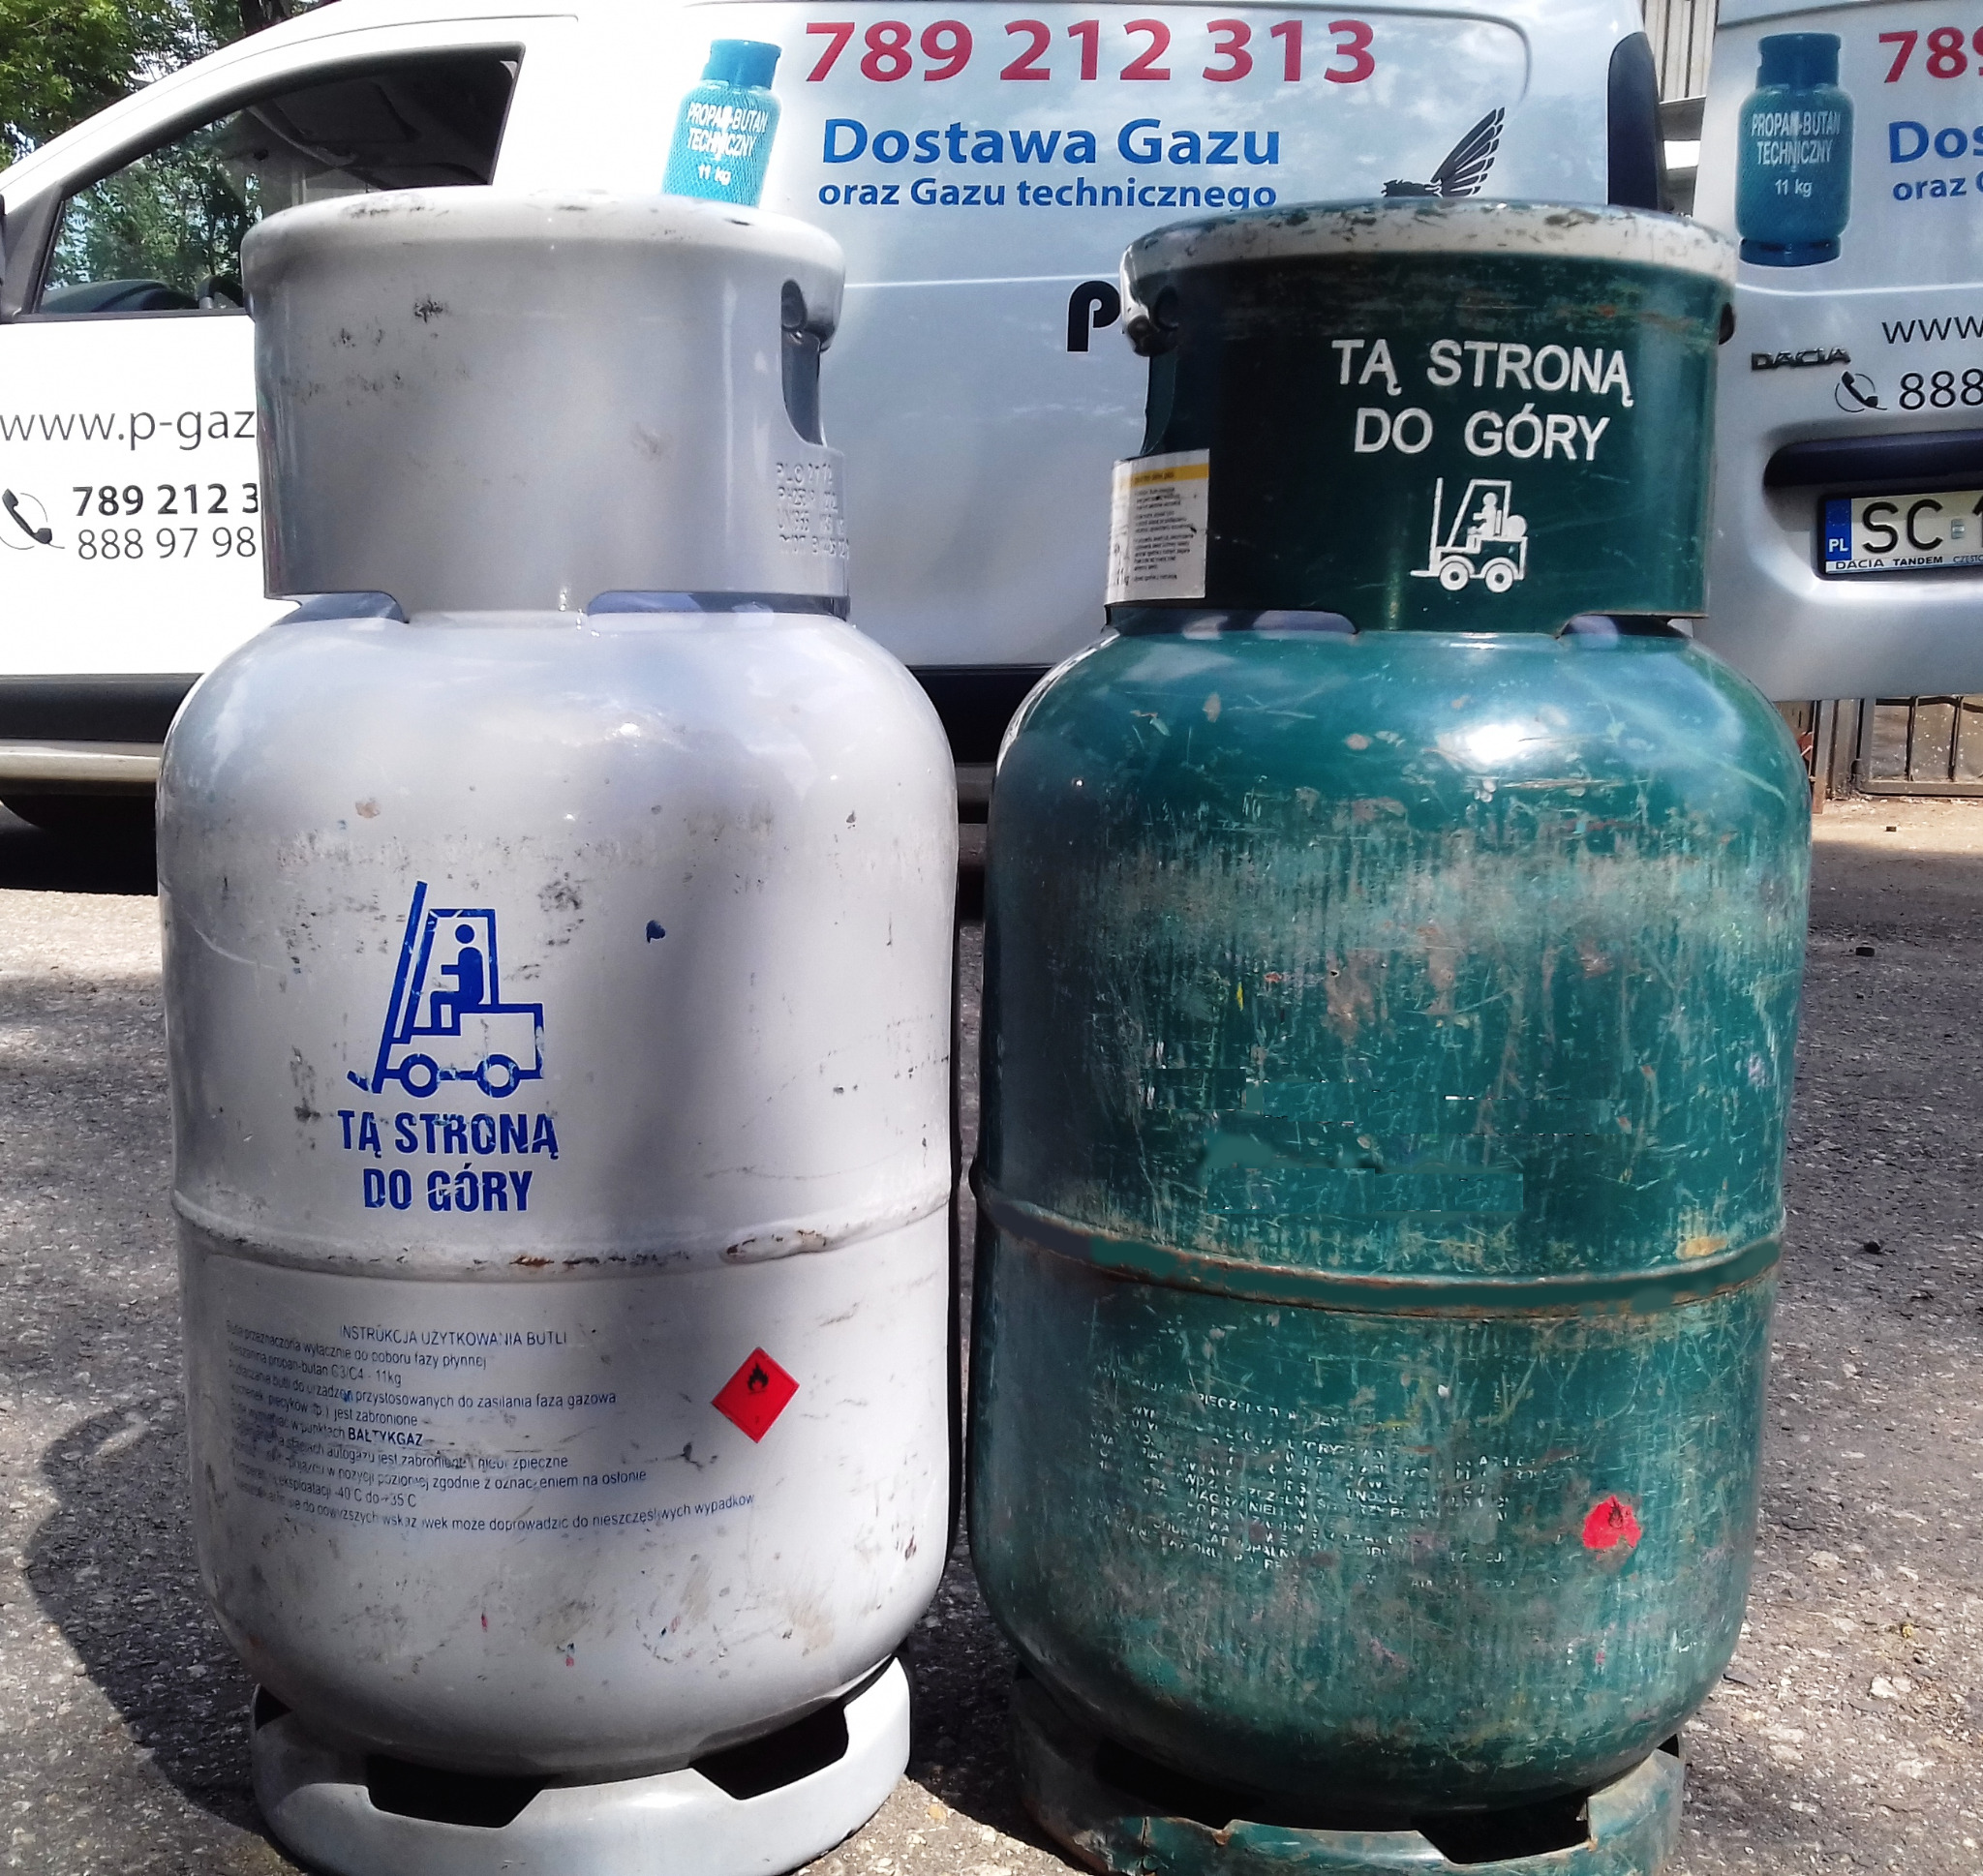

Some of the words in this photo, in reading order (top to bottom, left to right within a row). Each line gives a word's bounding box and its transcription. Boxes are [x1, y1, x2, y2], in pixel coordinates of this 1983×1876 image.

[805, 20, 973, 82] 789
[999, 19, 1171, 82] 212
[1202, 19, 1375, 84] 313
[1878, 25, 1983, 83] 78
[822, 118, 1097, 165] Dostawa
[1117, 117, 1280, 165] Gazu
[1756, 139, 1834, 166] TECHNICZNY
[697, 164, 712, 181] 11
[715, 166, 733, 186] kg
[1774, 178, 1789, 196] 11
[1795, 178, 1814, 197] kg
[818, 183, 901, 206] oraz
[910, 177, 1006, 207] Gazu
[1016, 178, 1278, 211] technicznego
[1892, 177, 1968, 201] oraz
[1750, 347, 1851, 372] DACIA
[1331, 338, 1402, 397] TĄ
[1426, 340, 1634, 408] STRONĄ
[1899, 368, 1983, 410] 888
[1355, 407, 1434, 454] DO
[1463, 403, 1611, 462] GÓRY
[73, 484, 144, 517] 789
[157, 483, 229, 515] 212
[242, 482, 259, 514] 3
[1861, 498, 1944, 555] SC
[77, 528, 144, 560] 888
[156, 527, 198, 559] 97
[212, 526, 257, 559] 98
[1828, 537, 1849, 553] PL
[1835, 558, 1885, 570] DACIA
[1892, 555, 1944, 567] TANDEM
[337, 1109, 382, 1159] TĄ
[394, 1111, 560, 1161] STRONĄ
[362, 1167, 412, 1211] DO
[426, 1162, 534, 1212] GÓRY
[526, 1330, 567, 1346] BUTLI
[354, 1348, 369, 1361] do
[458, 1394, 473, 1407] do
[334, 1407, 353, 1423] jest
[355, 1409, 418, 1427] zabronione
[432, 1475, 480, 1492] zgodnie
[484, 1477, 491, 1490] z
[582, 1474, 598, 1486] na
[601, 1469, 647, 1486] osłonie
[365, 1491, 381, 1504] do
[572, 1514, 589, 1528] do
